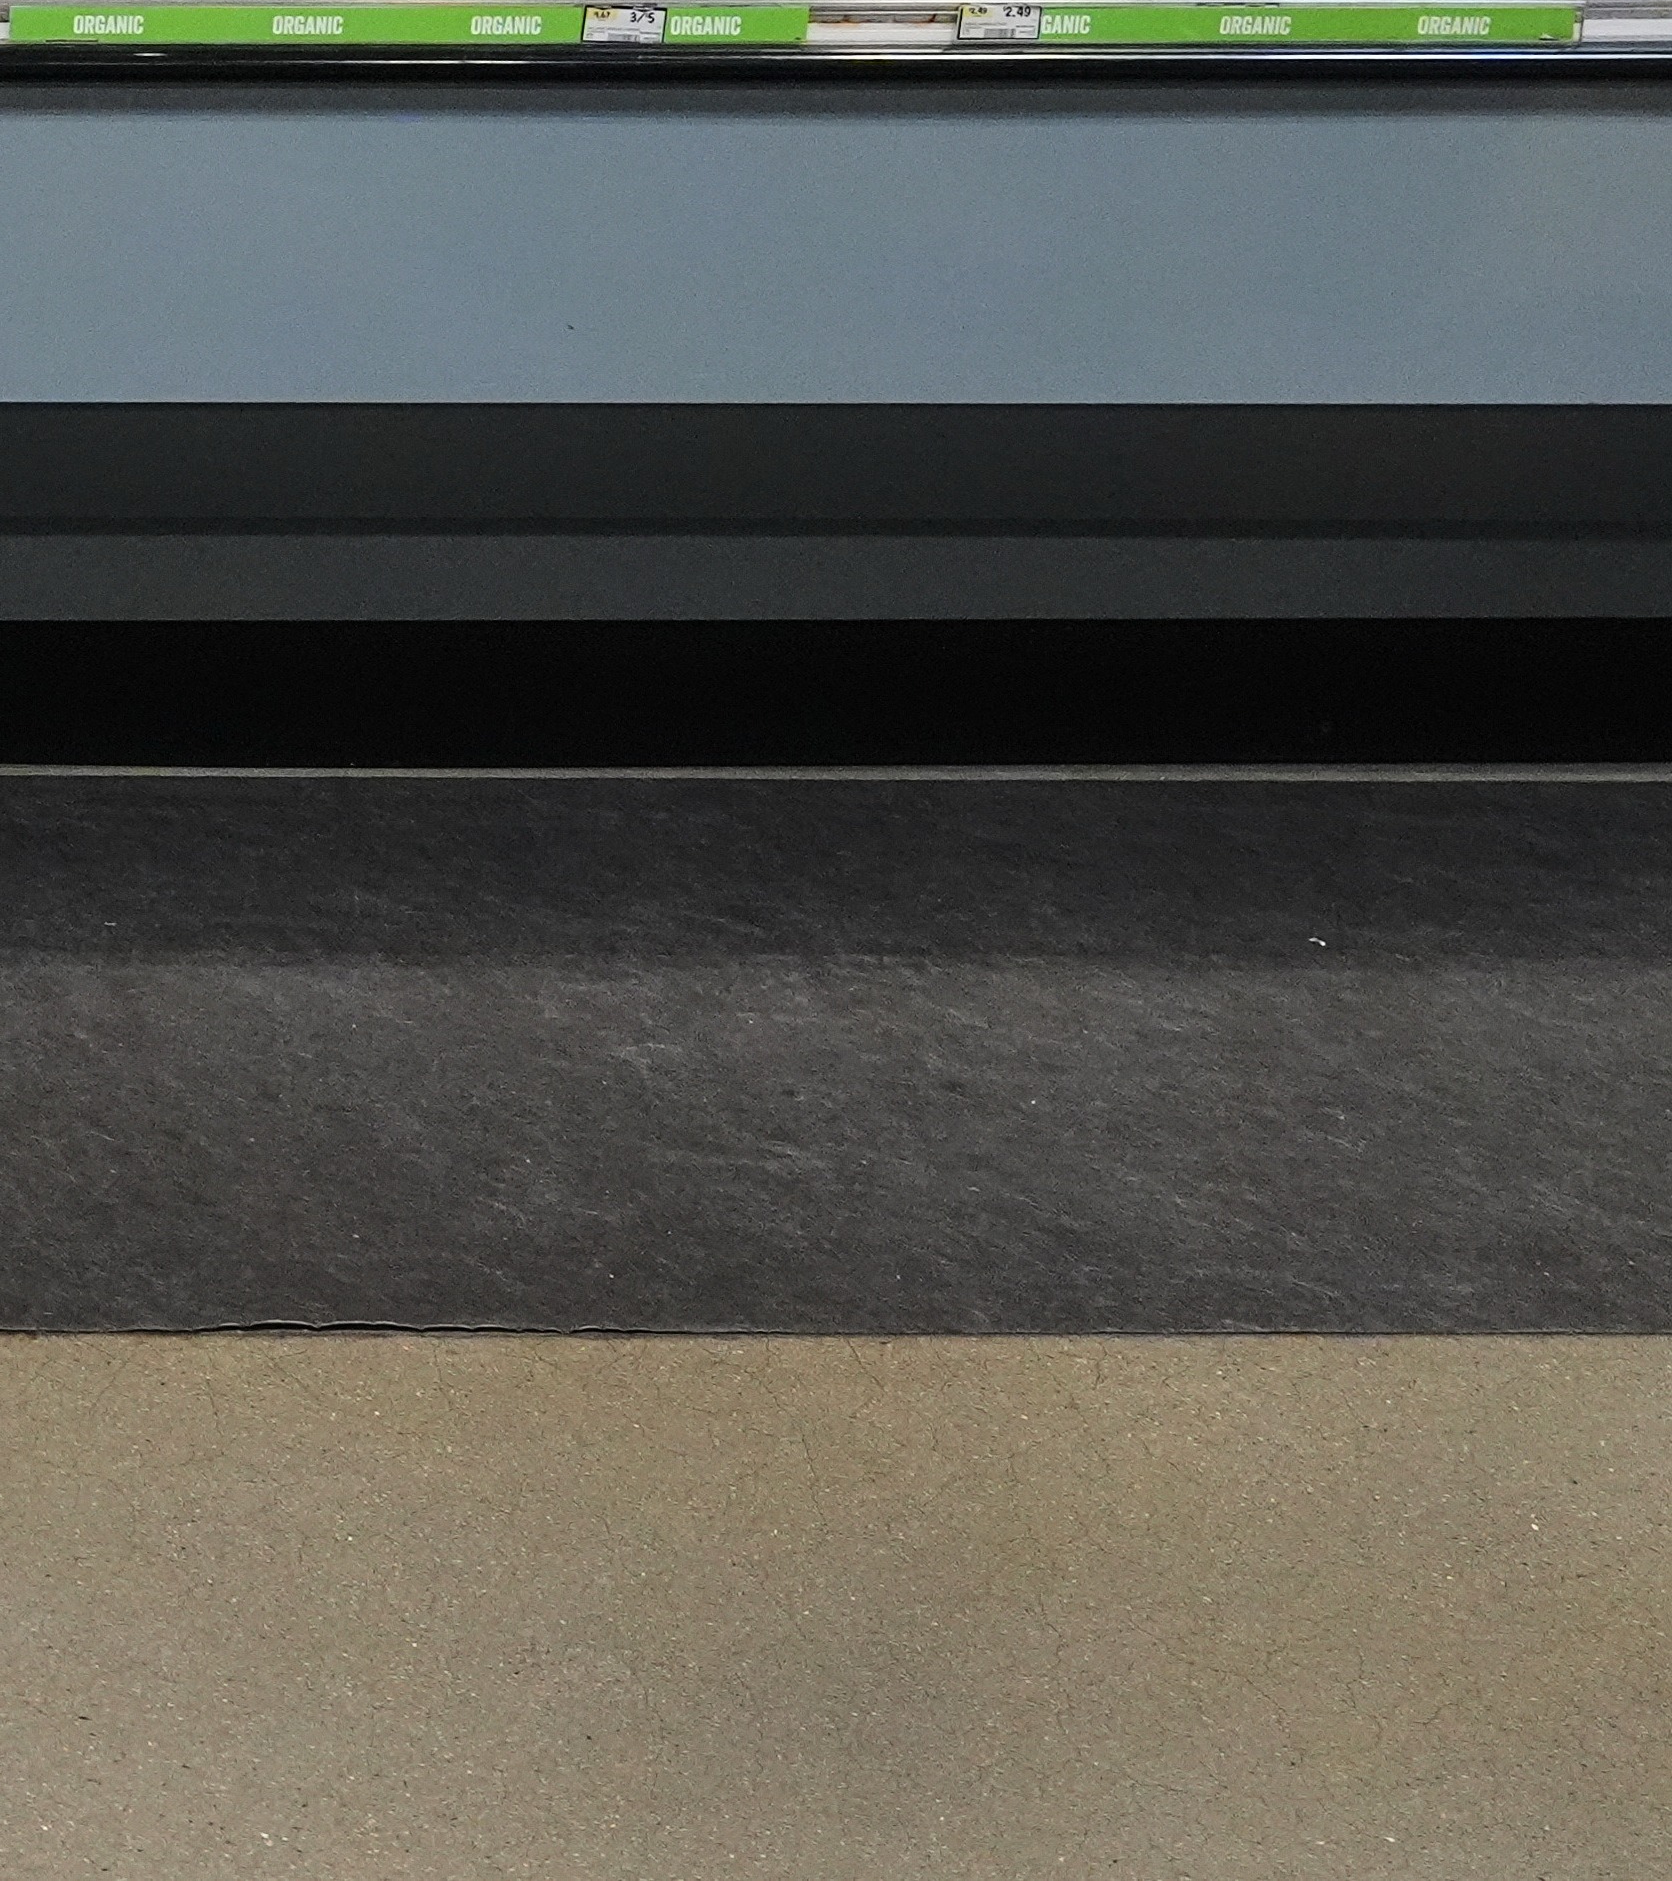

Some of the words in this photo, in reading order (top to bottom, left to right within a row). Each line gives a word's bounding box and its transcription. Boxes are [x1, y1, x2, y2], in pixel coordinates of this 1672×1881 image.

[73, 15, 144, 34] ORGANIC
[272, 15, 343, 35] ORGANIC
[470, 16, 542, 35] ORGANIC
[670, 17, 741, 35] ORGANIC
[1041, 15, 1091, 34] GANIC
[1219, 16, 1292, 35] ORGANIC
[1417, 16, 1491, 35] ORGANIC
